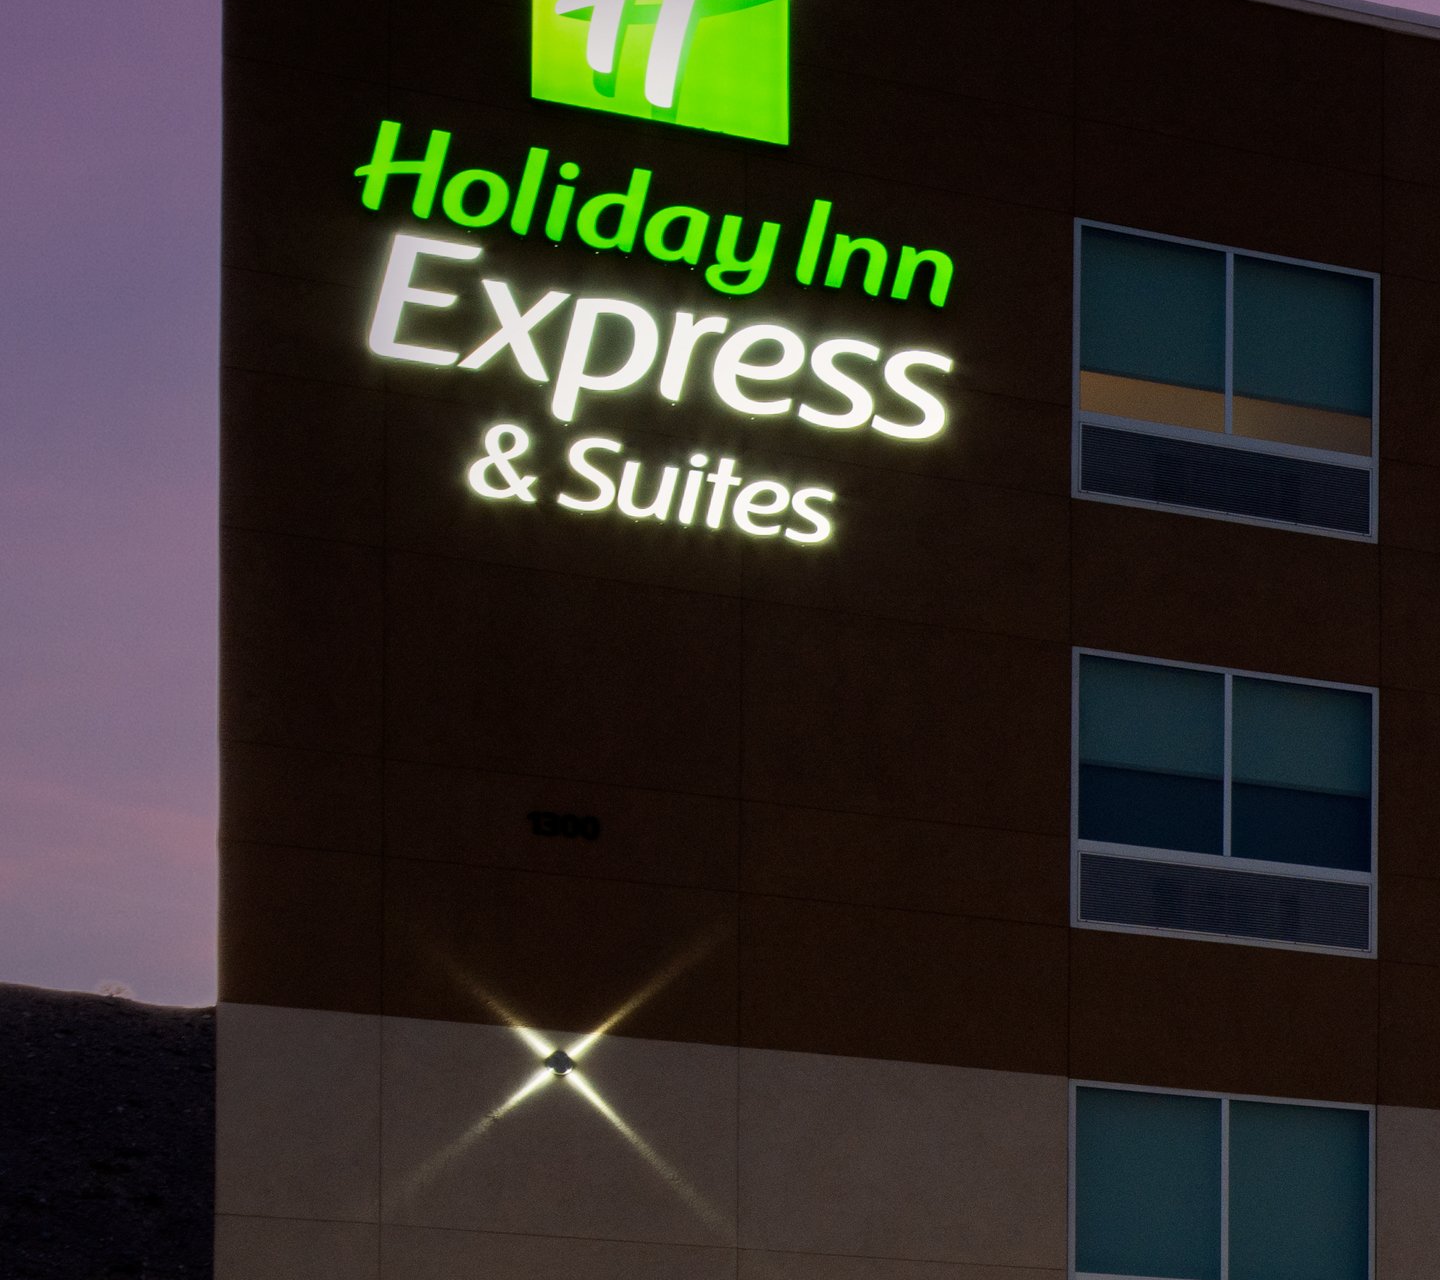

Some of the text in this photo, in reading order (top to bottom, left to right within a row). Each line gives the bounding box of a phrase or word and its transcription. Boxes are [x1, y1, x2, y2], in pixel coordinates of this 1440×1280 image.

[354, 120, 955, 307] Holiday Inn
[366, 232, 954, 441] Express
[467, 423, 837, 544] & Suites
